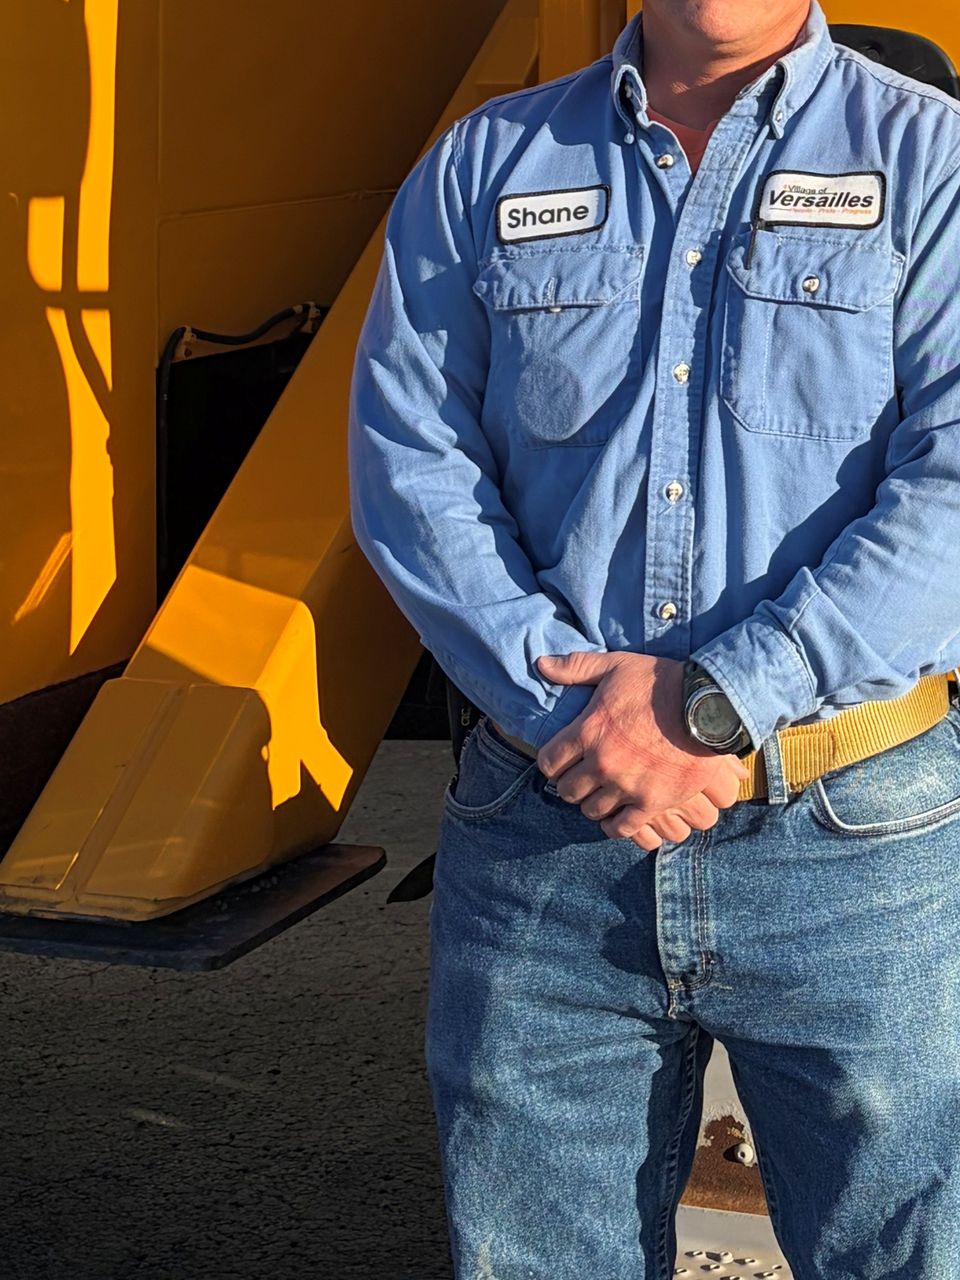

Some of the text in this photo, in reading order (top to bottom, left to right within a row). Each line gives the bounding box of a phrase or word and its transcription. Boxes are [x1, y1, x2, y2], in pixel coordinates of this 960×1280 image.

[769, 190, 874, 208] Versailles
[788, 185, 816, 195] Village
[507, 205, 590, 229] Shane
